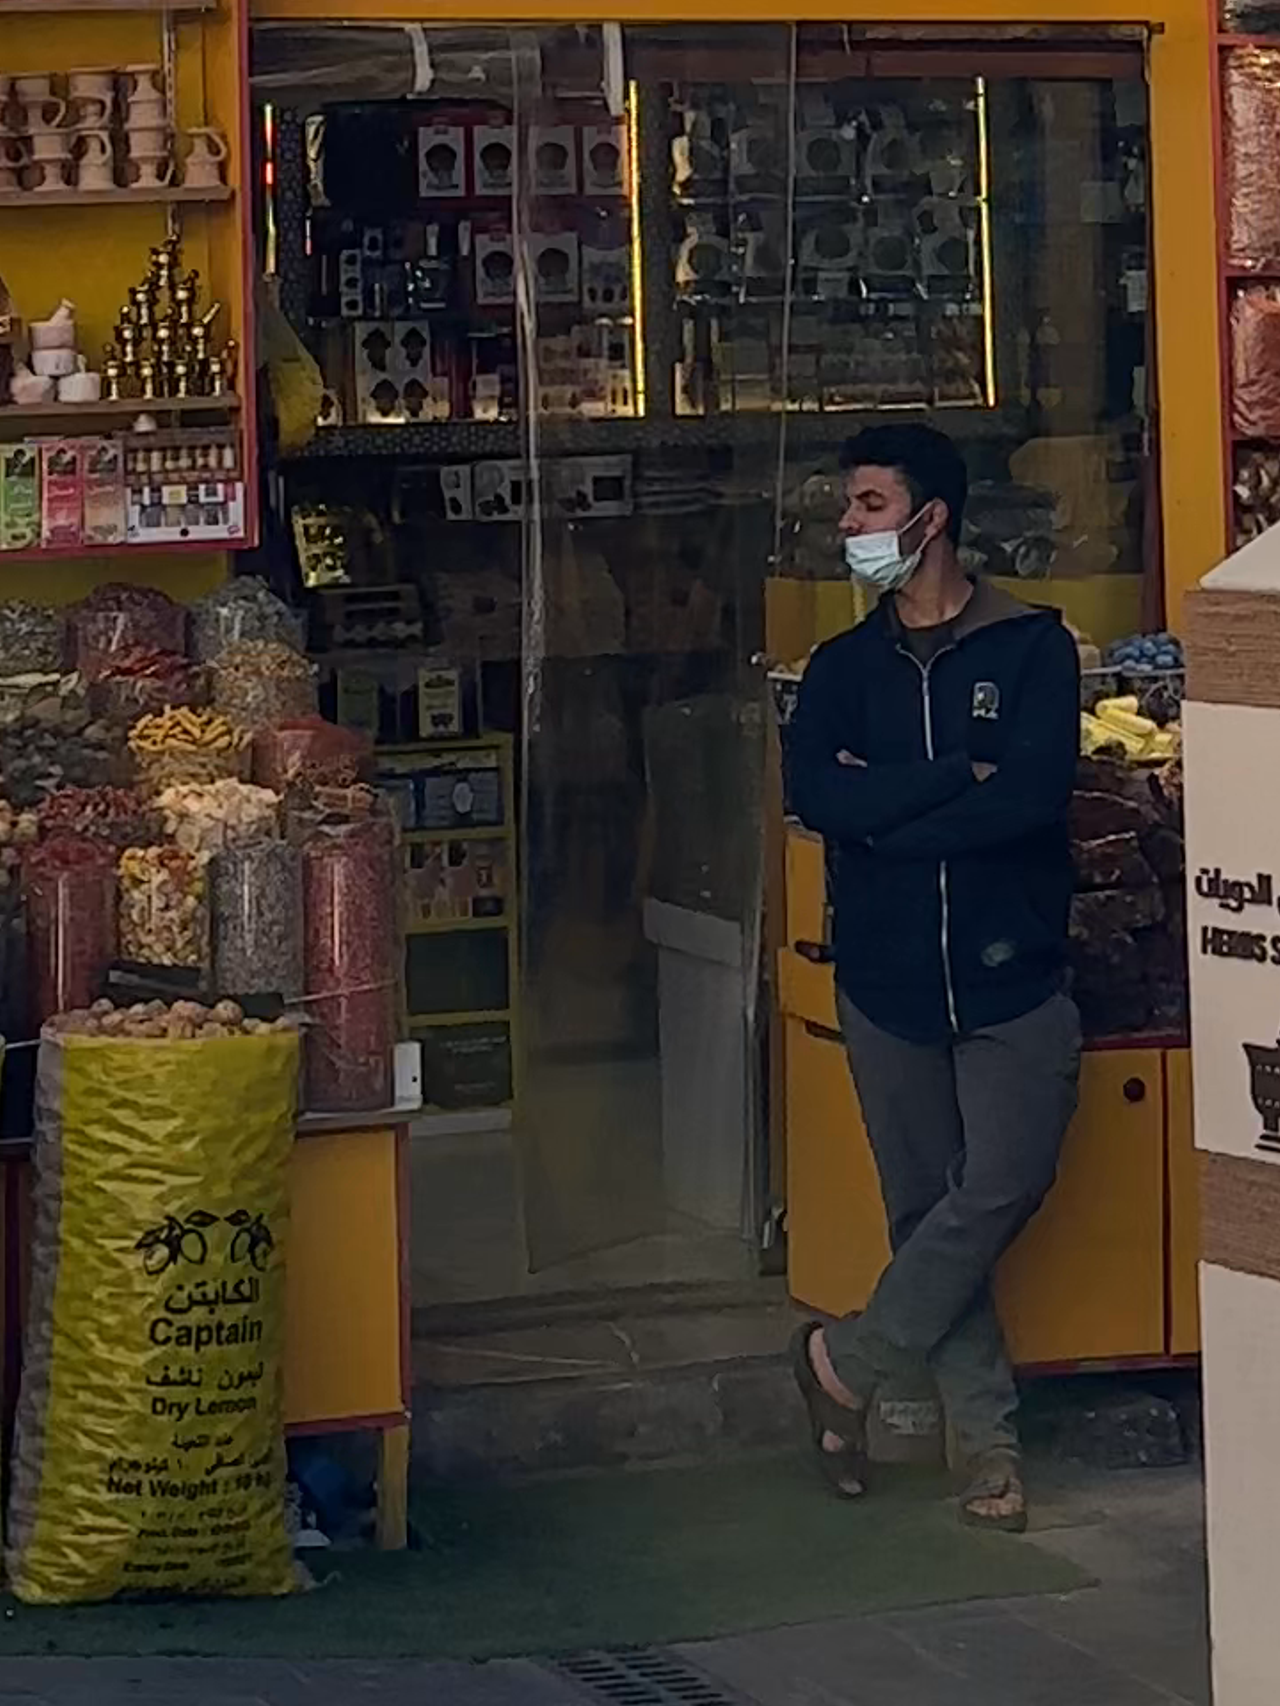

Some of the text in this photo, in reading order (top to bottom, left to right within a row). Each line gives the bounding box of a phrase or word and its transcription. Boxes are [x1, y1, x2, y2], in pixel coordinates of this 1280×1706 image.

[1201, 925, 1267, 963] HERBS
[164, 1276, 260, 1315] الكابتن
[149, 1315, 263, 1353] Captain
[151, 1397, 256, 1422] Dry Lemon
[149, 1478, 217, 1500] Weight
